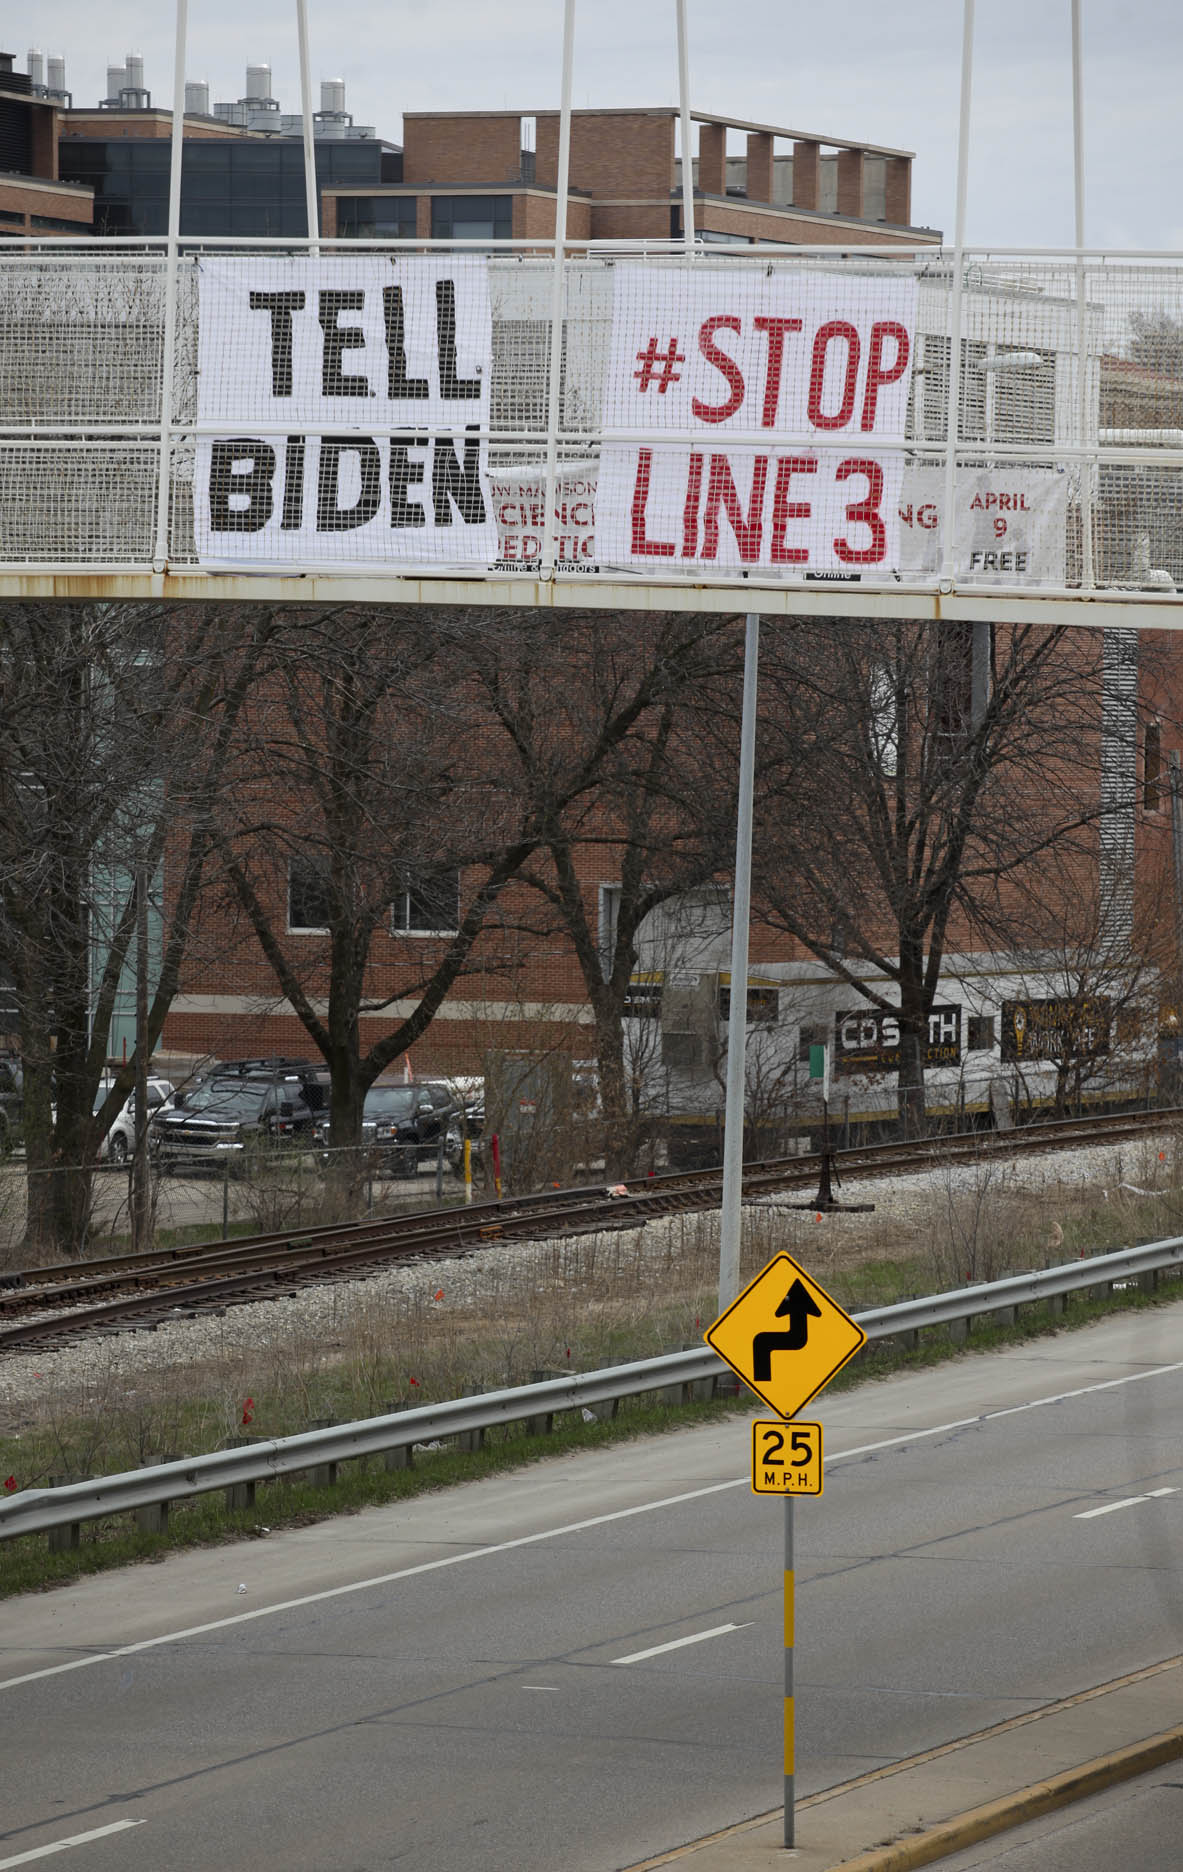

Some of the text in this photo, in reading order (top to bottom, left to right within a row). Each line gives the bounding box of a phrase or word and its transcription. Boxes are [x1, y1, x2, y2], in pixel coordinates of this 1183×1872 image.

[249, 279, 481, 400] TELL
[633, 315, 909, 431] #STOP
[209, 424, 486, 532] BIDEN
[495, 503, 595, 527] CIENC
[970, 492, 1031, 511] APRIL
[993, 517, 1008, 538] 9
[970, 551, 1027, 572] FREE
[881, 1013, 957, 1047] STH
[762, 1430, 812, 1467] 25
[764, 1472, 812, 1487] M.P.H.
